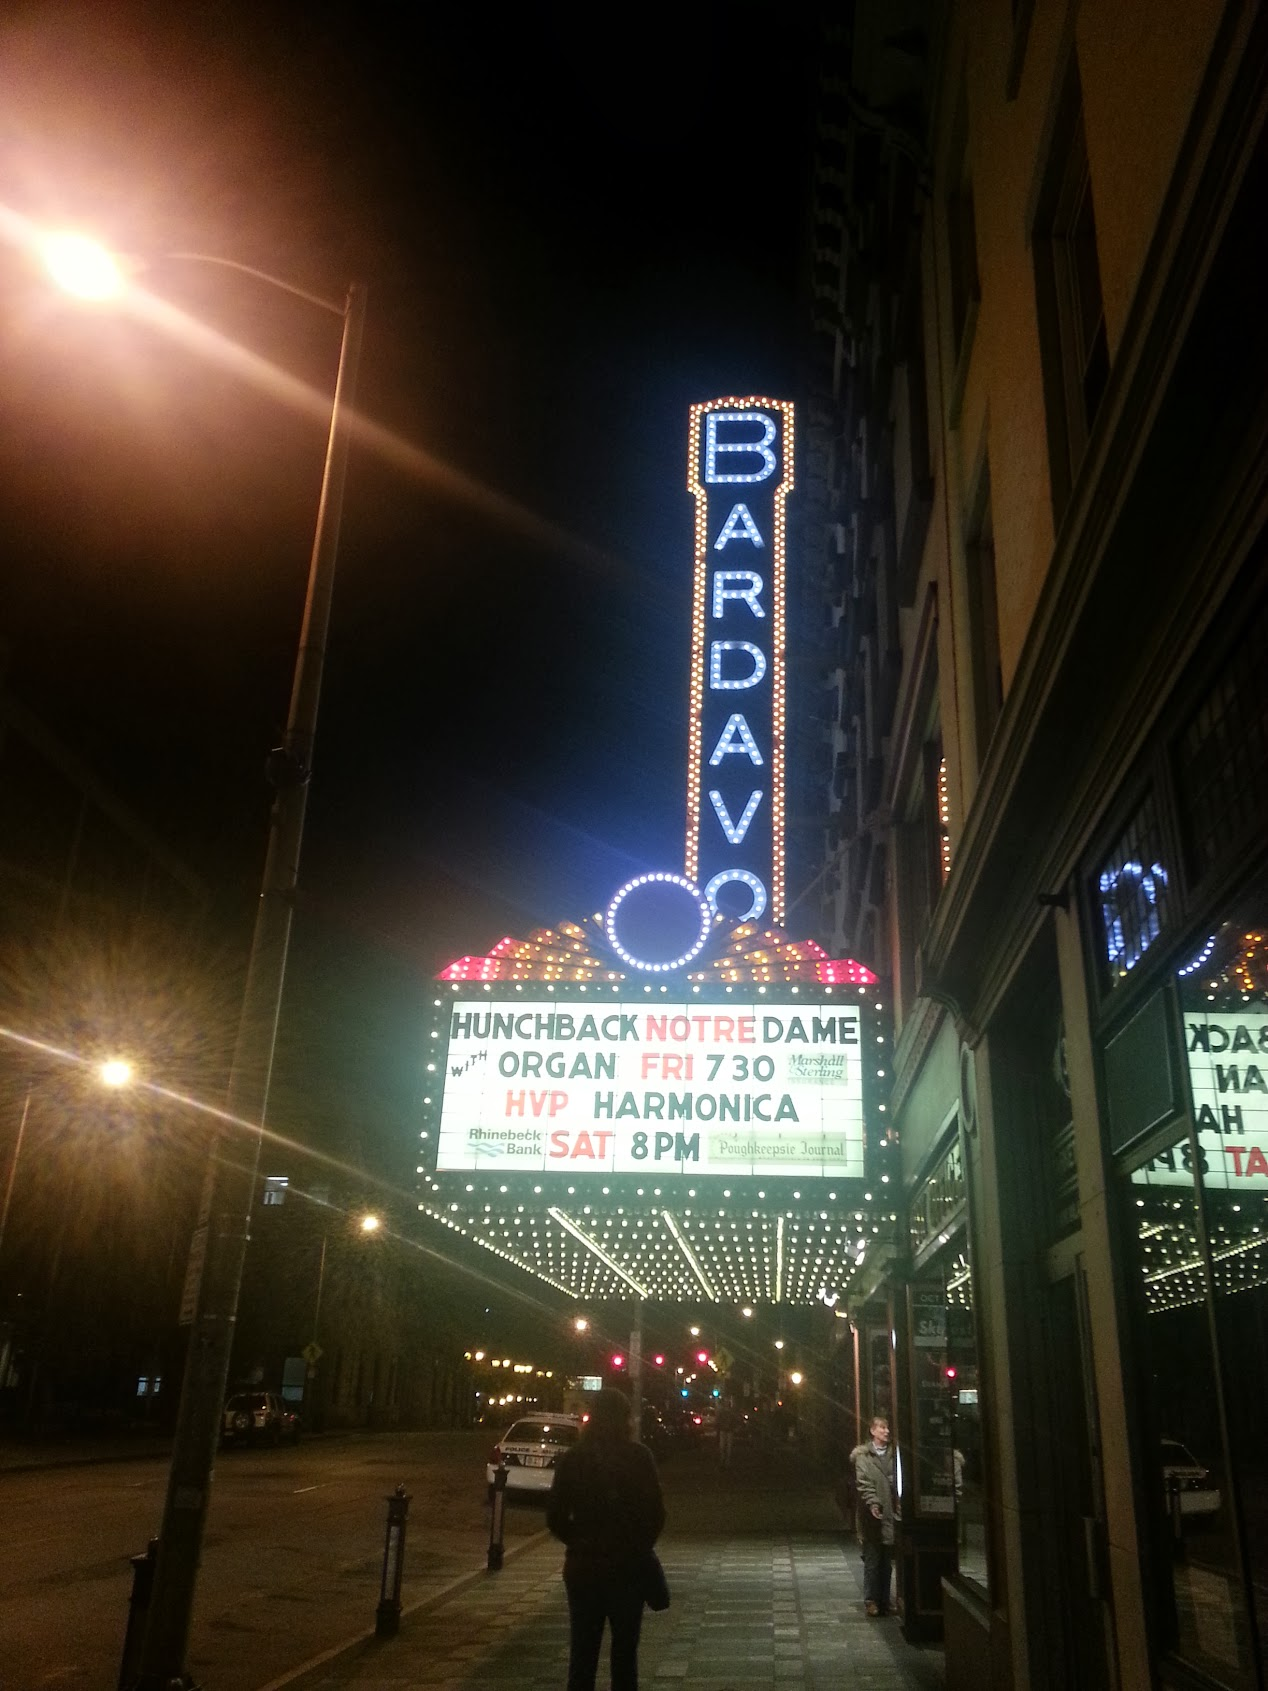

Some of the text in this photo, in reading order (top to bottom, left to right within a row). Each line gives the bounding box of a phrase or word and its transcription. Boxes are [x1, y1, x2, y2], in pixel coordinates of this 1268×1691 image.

[451, 1012, 858, 1044] HUNCHBACK NOTRE DAME
[451, 1050, 775, 1082] WITH ORGAN FRI 730
[787, 1054, 845, 1067] Marshall
[504, 1089, 800, 1122] HVP HARMONICA
[469, 1128, 541, 1141] Rhinebeck
[549, 1130, 700, 1162] SAT 8PM
[506, 1143, 542, 1155] Bank
[719, 1139, 844, 1157] Poughkeepsie Journal
